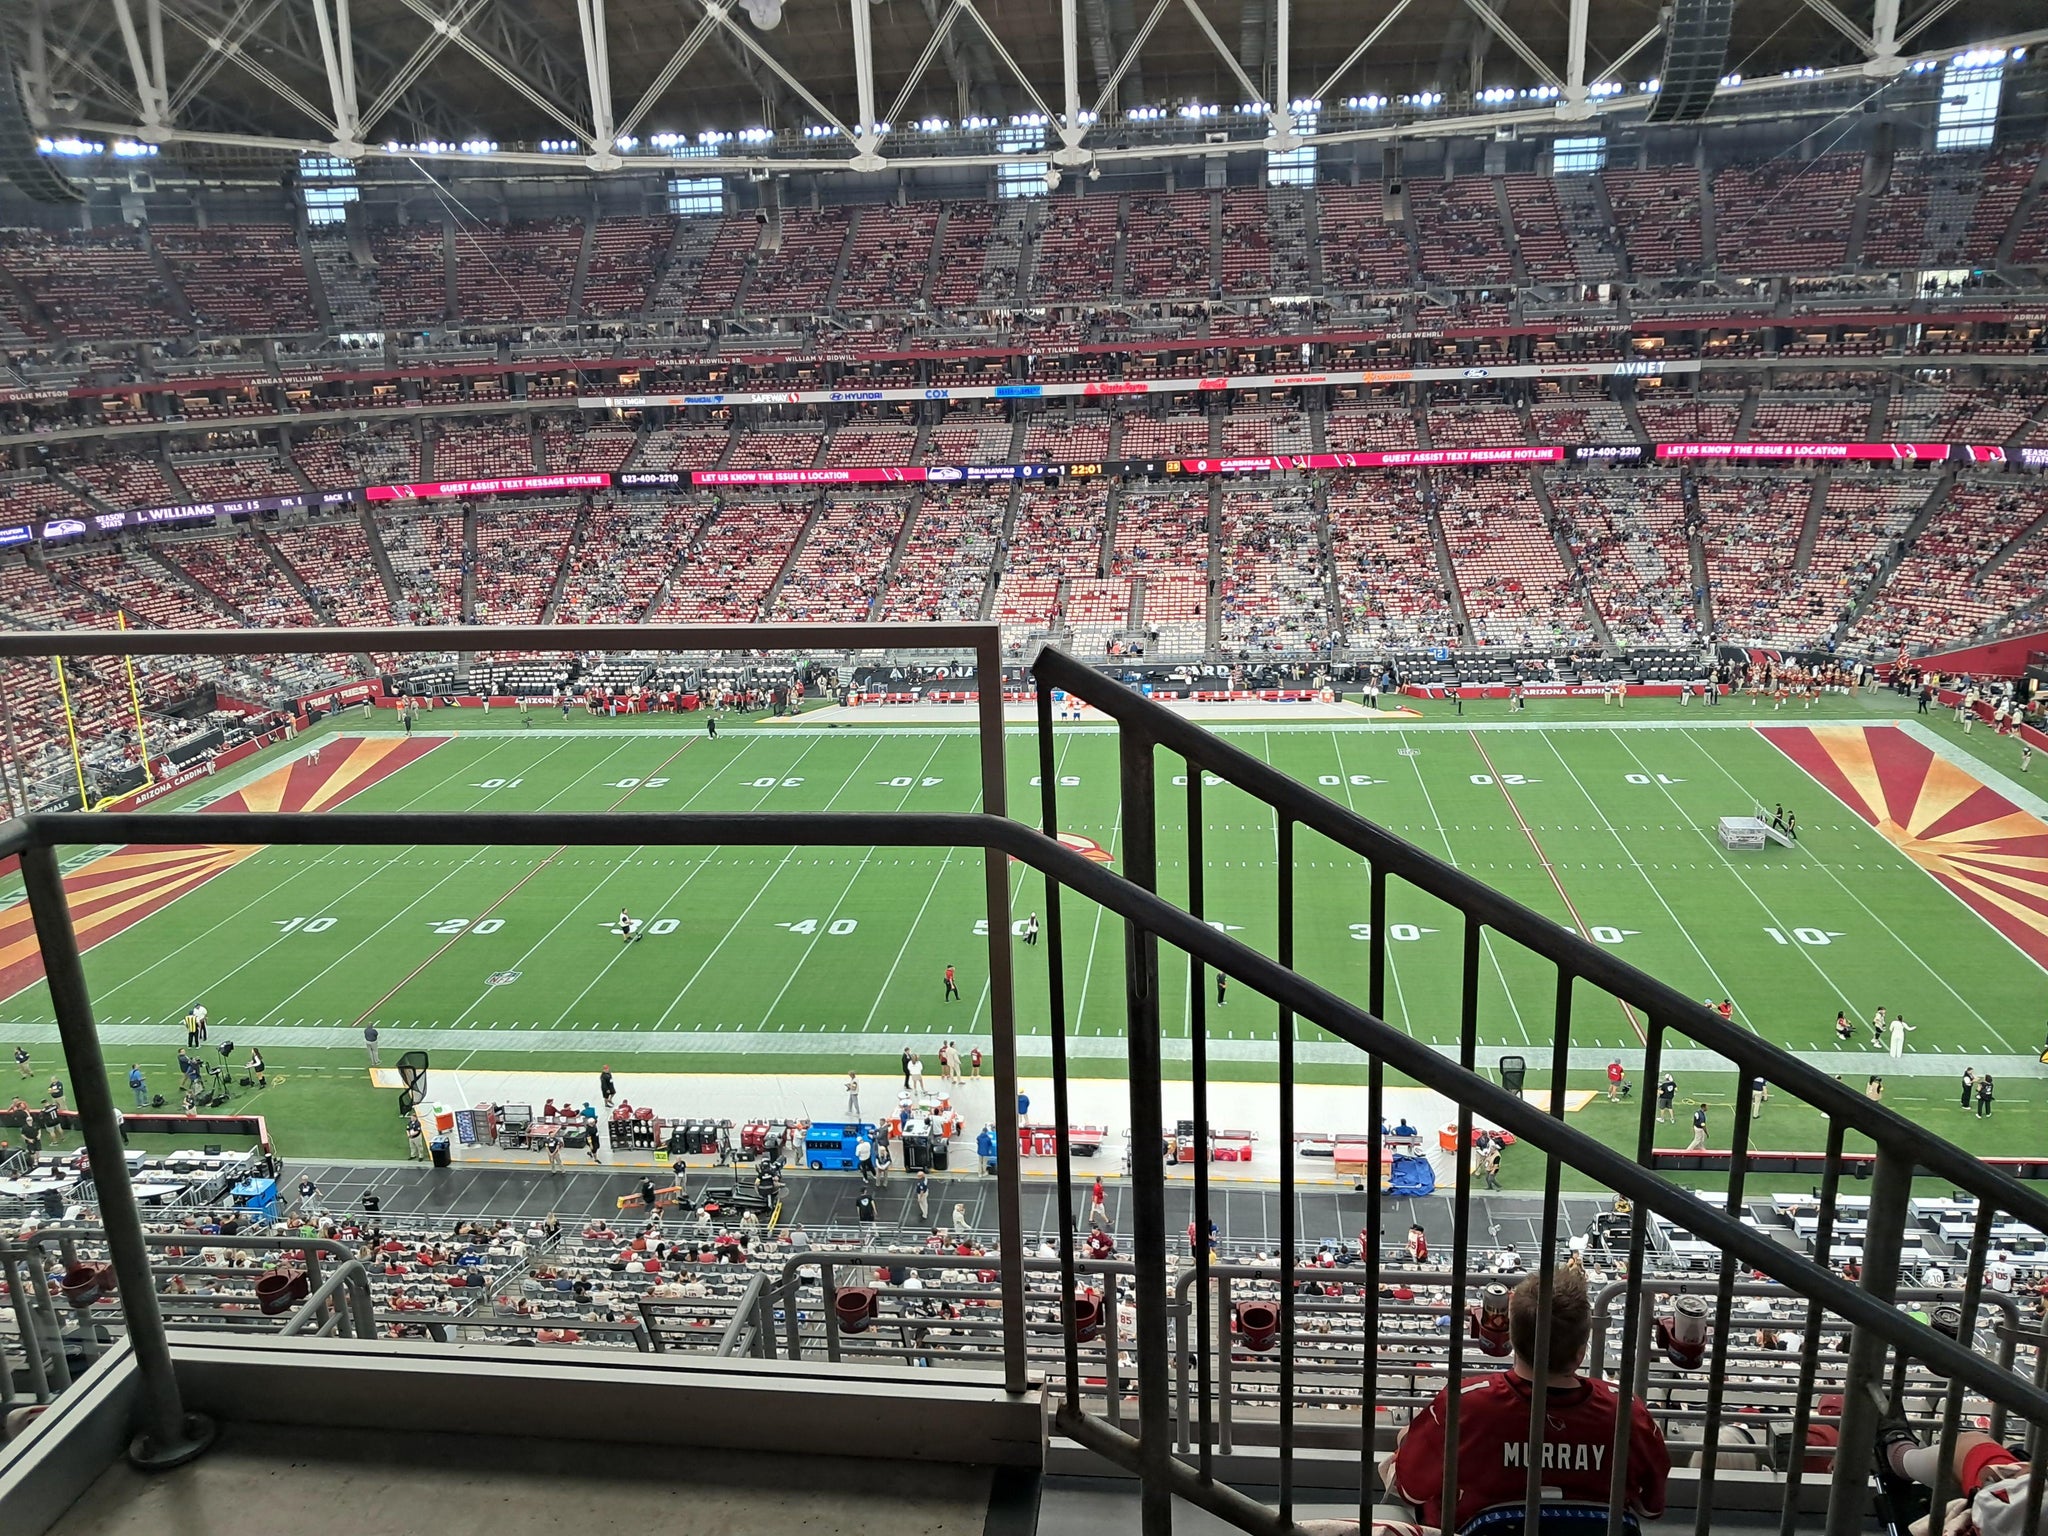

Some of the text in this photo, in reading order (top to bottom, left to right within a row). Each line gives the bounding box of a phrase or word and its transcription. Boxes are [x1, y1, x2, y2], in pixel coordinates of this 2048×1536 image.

[1567, 325, 1602, 333] CHARLEY
[1603, 324, 1632, 332] TRIPPI
[1386, 332, 1412, 340] ROGER
[1615, 361, 1665, 376] AVNET
[284, 375, 324, 383] WILLIAMS
[1199, 378, 1229, 389] Coca-Cola
[9, 392, 34, 401] OLLIE
[35, 390, 69, 399] MATSON
[751, 394, 788, 402] SAFEWAY
[844, 392, 883, 400] HYUNDAI
[925, 390, 949, 399] COX
[614, 397, 646, 405] BETMGM
[1382, 448, 1553, 463] GUEST ASSIST TEXT MESSAGE HOTLINE
[1576, 446, 1642, 457] 623-400-2210
[1667, 446, 1684, 455] LET
[1686, 446, 1699, 454] US
[1700, 446, 1731, 454] KNOW
[1733, 446, 1751, 454] THE
[1755, 446, 1784, 455] ISSUE
[1794, 446, 1847, 455] LOCATION
[2021, 448, 2048, 456] SEASO
[1220, 459, 1271, 467] CARDINALS
[967, 465, 1032, 476] SEAHAWKS 0
[1070, 464, 1102, 475] 22:01
[621, 474, 679, 484] 623-400-2210
[701, 472, 717, 481] LET
[717, 472, 729, 481] US
[731, 472, 756, 481] KNOW
[757, 472, 775, 481] THE
[775, 472, 799, 481] ISSUE
[807, 471, 849, 480] LOCATION
[440, 476, 602, 493] GUEST ASSIST TEXT MESSAGE HOTLINE
[280, 496, 302, 507] TFL 1
[323, 491, 352, 502] SACK 1
[223, 500, 260, 512] TKLS 15
[95, 512, 125, 523] SEASON
[136, 504, 215, 522] L. WILLIAMS
[101, 519, 122, 529] STATS
[1433, 649, 1443, 658] 12
[135, 761, 216, 805] ARIZONA CARDINAS
[480, 778, 523, 789] 10
[614, 778, 671, 789] 20
[752, 777, 804, 789] 30
[888, 776, 943, 788] 40
[1318, 775, 1373, 786] 30
[1469, 774, 1527, 785] 20
[1624, 774, 1676, 785] 10
[279, 916, 338, 934] 10
[433, 918, 506, 935] 20
[610, 918, 681, 934] 30
[789, 919, 858, 935] 40
[1348, 923, 1421, 942] 30
[1762, 926, 1832, 945] 10
[851, 1257, 862, 1265] 10
[1255, 1270, 1262, 1279] 8
[1680, 1284, 1687, 1294] 6
[1936, 1292, 1944, 1302] 5
[1120, 1314, 1133, 1325] 85
